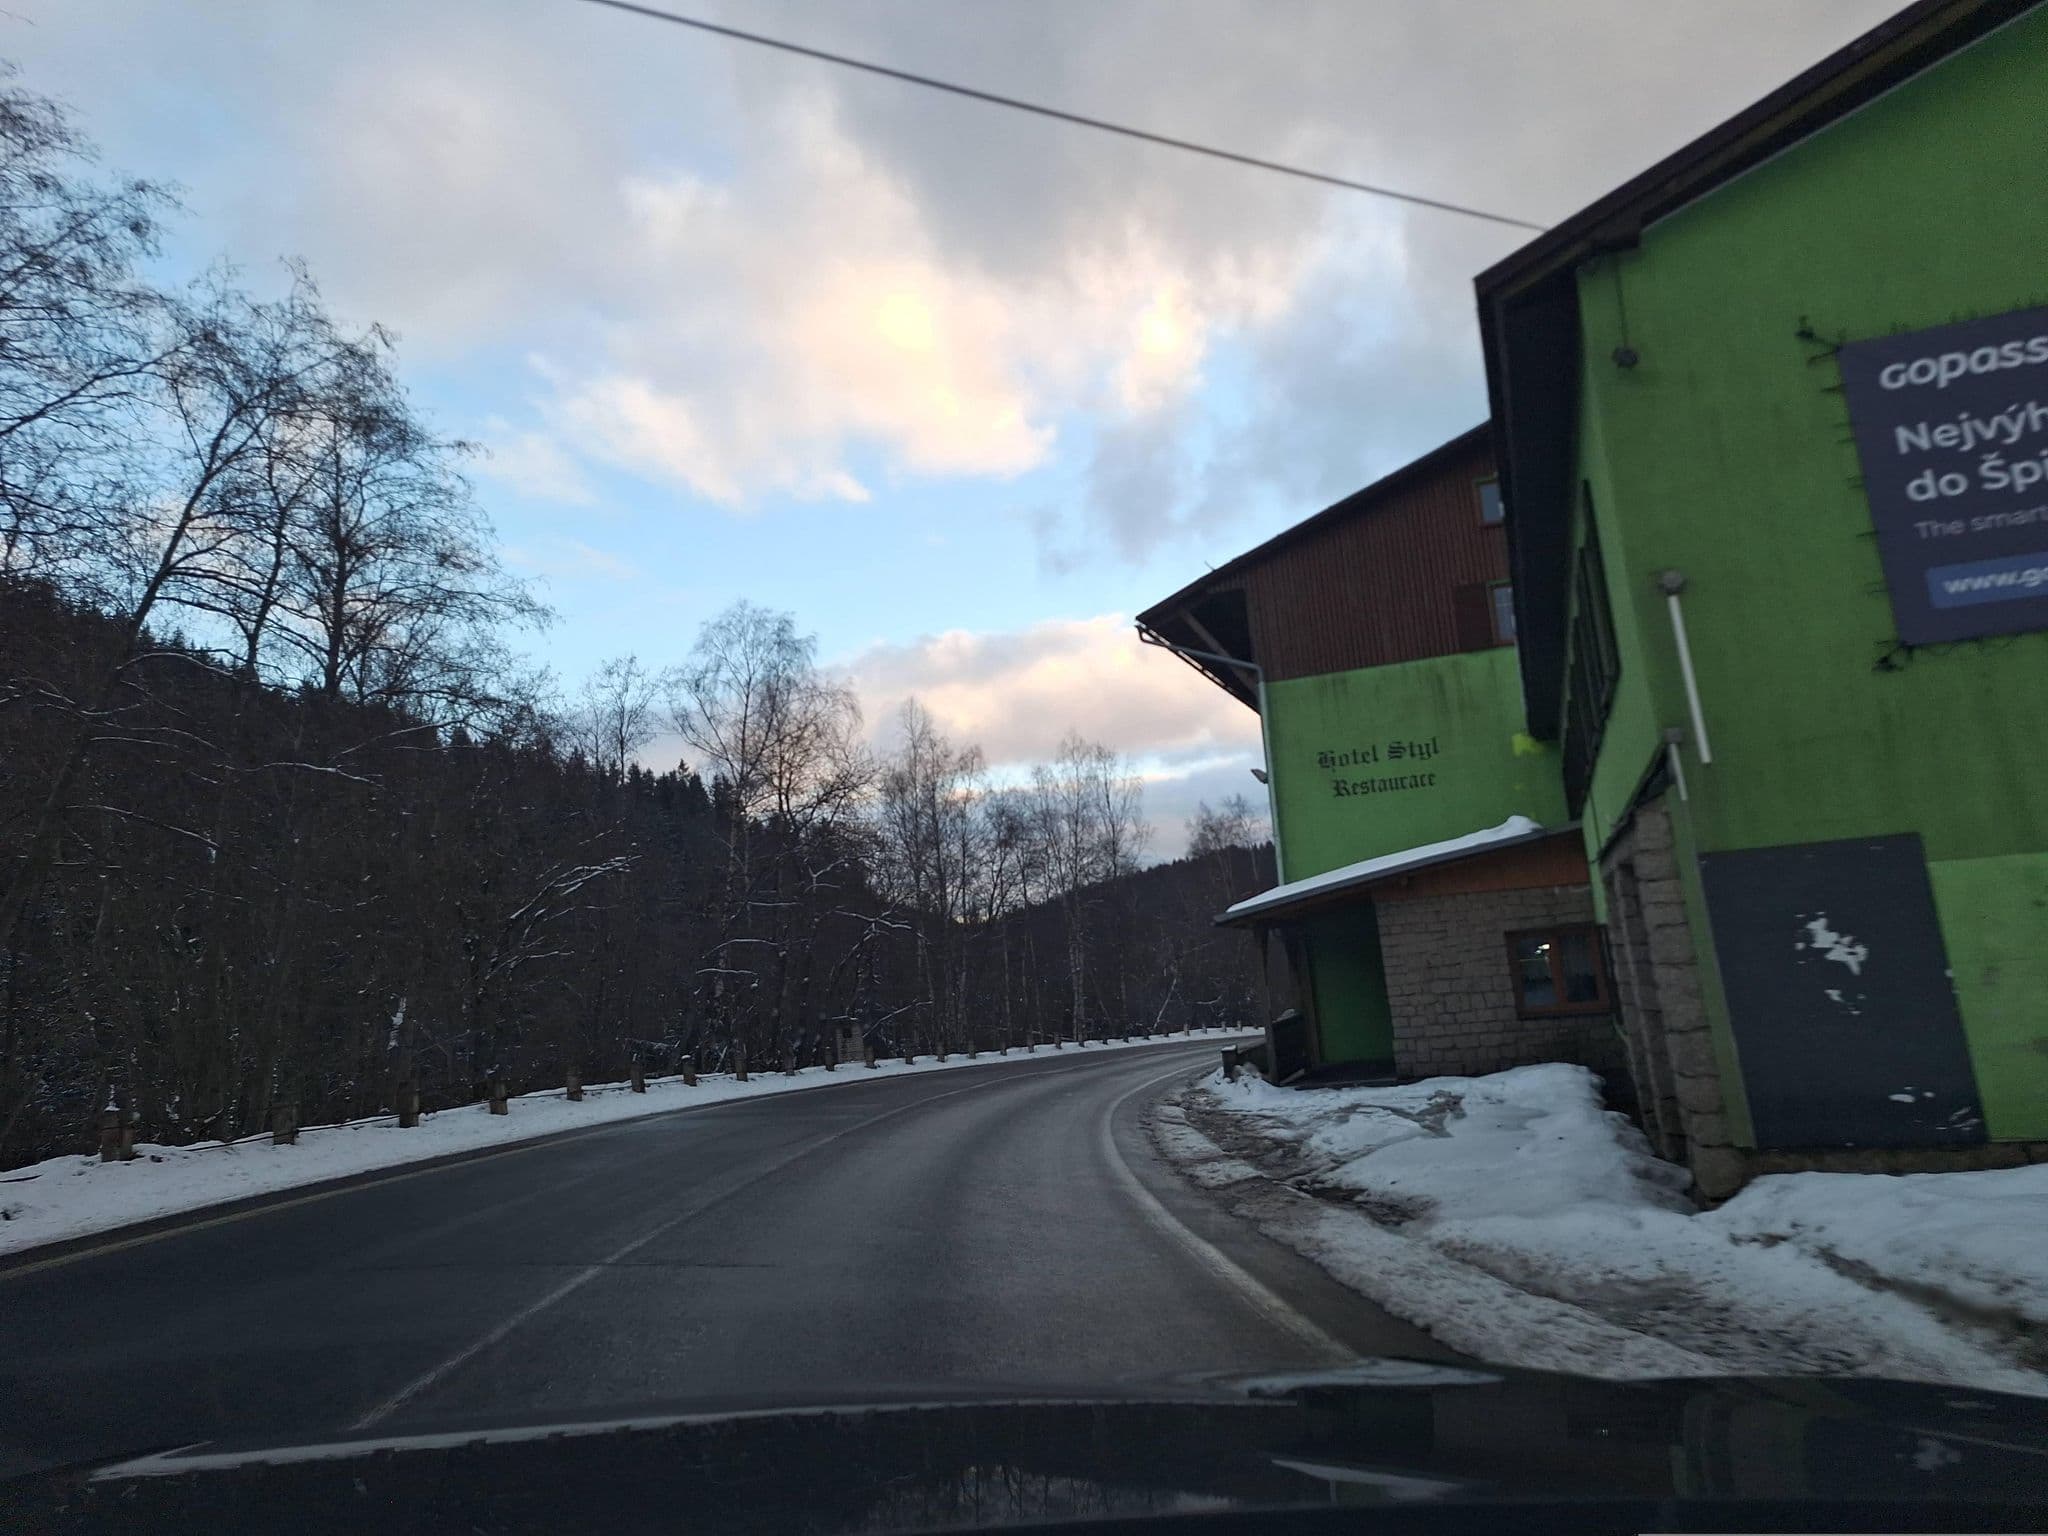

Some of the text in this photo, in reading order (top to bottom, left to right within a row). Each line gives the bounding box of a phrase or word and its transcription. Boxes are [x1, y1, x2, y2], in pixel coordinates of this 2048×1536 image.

[1895, 401, 2048, 454] Nejvýh
[1906, 468, 1969, 501] do
[1913, 519, 1966, 538] The
[1317, 736, 1440, 772] Hotel Styl
[1332, 772, 1437, 798] Restaurace
